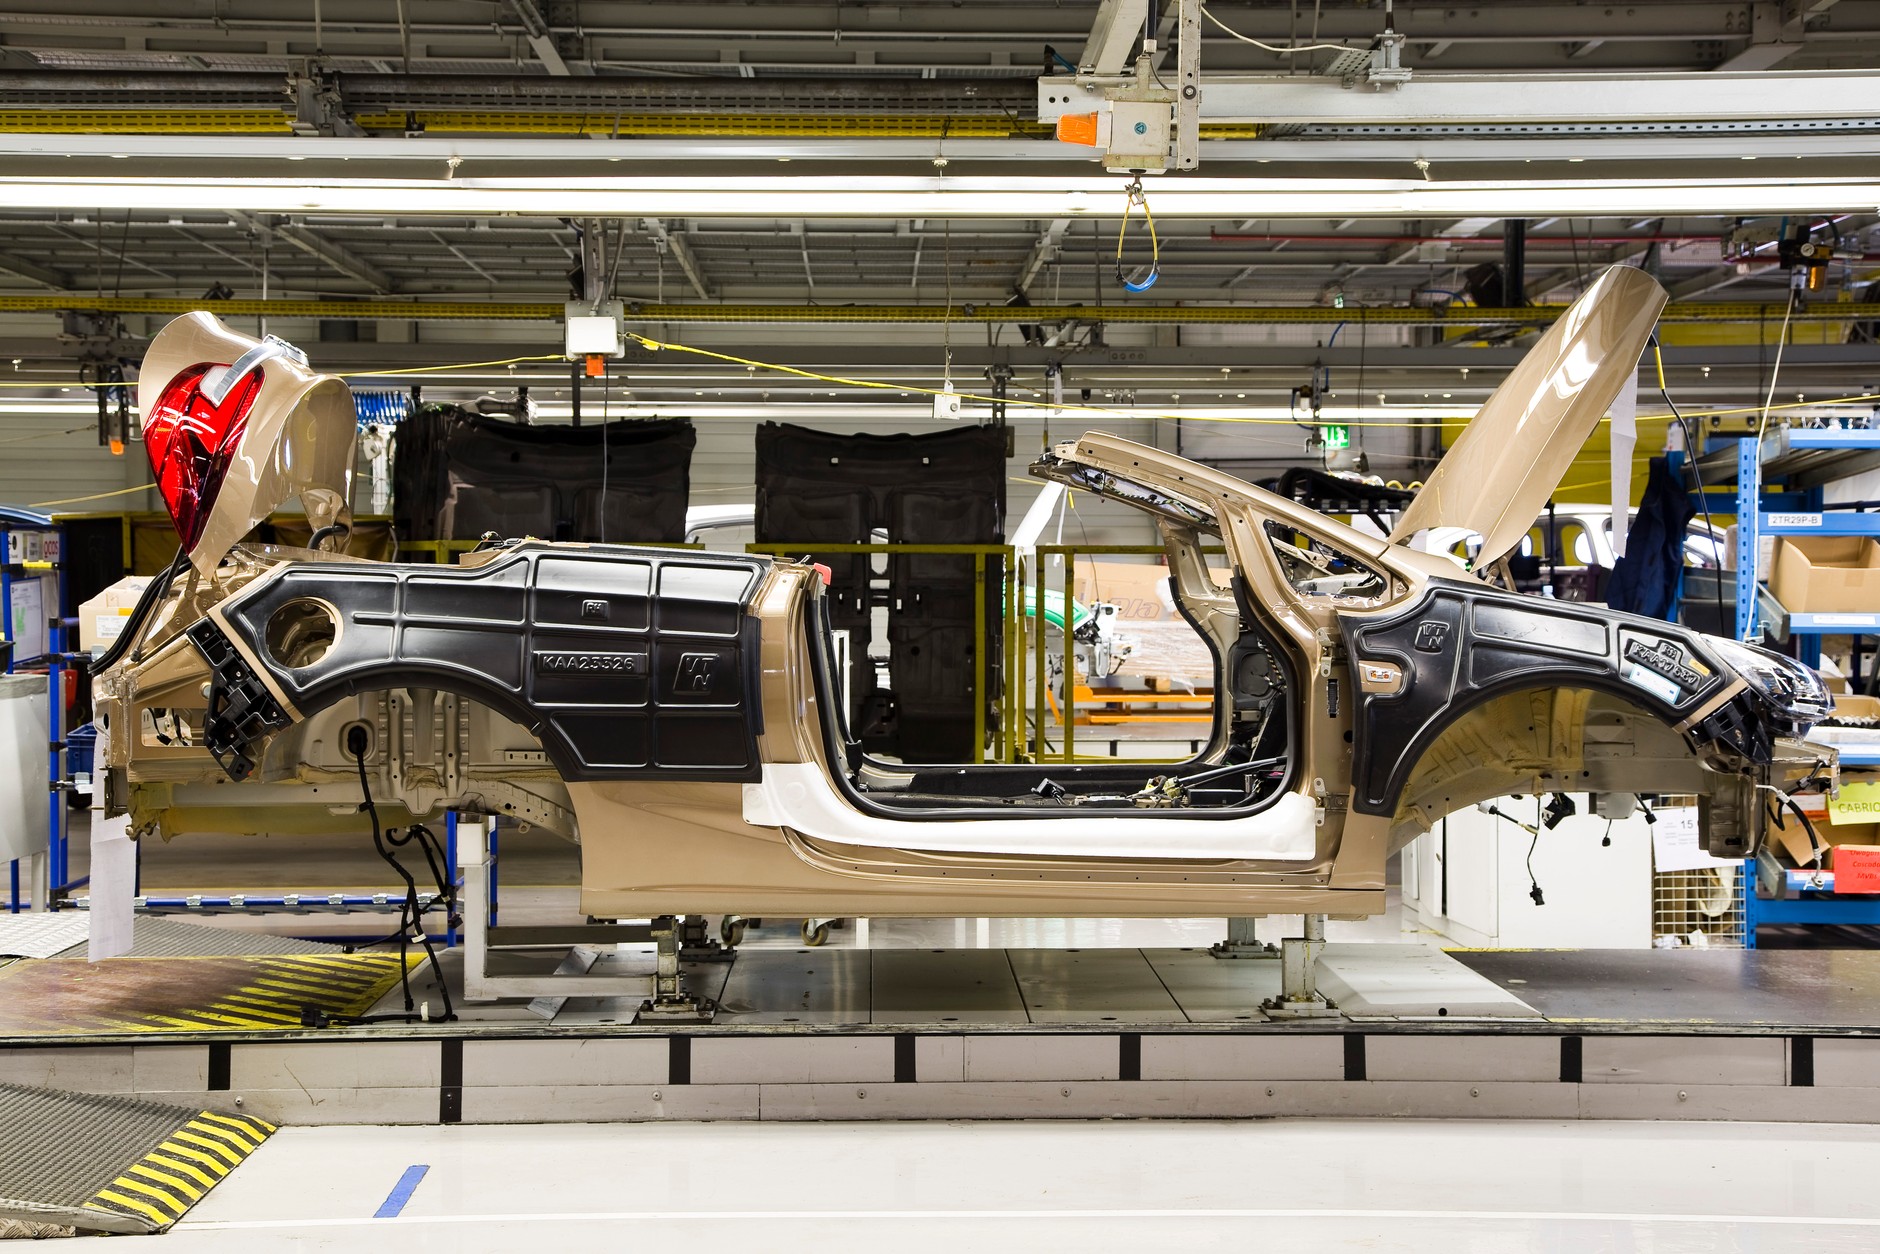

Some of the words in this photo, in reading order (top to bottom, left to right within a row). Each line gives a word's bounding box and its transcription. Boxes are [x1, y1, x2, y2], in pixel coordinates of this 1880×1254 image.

[1772, 515, 1818, 524] 2TR29P-B
[1838, 802, 1880, 814] CABRIO
[1681, 819, 1694, 829] 15
